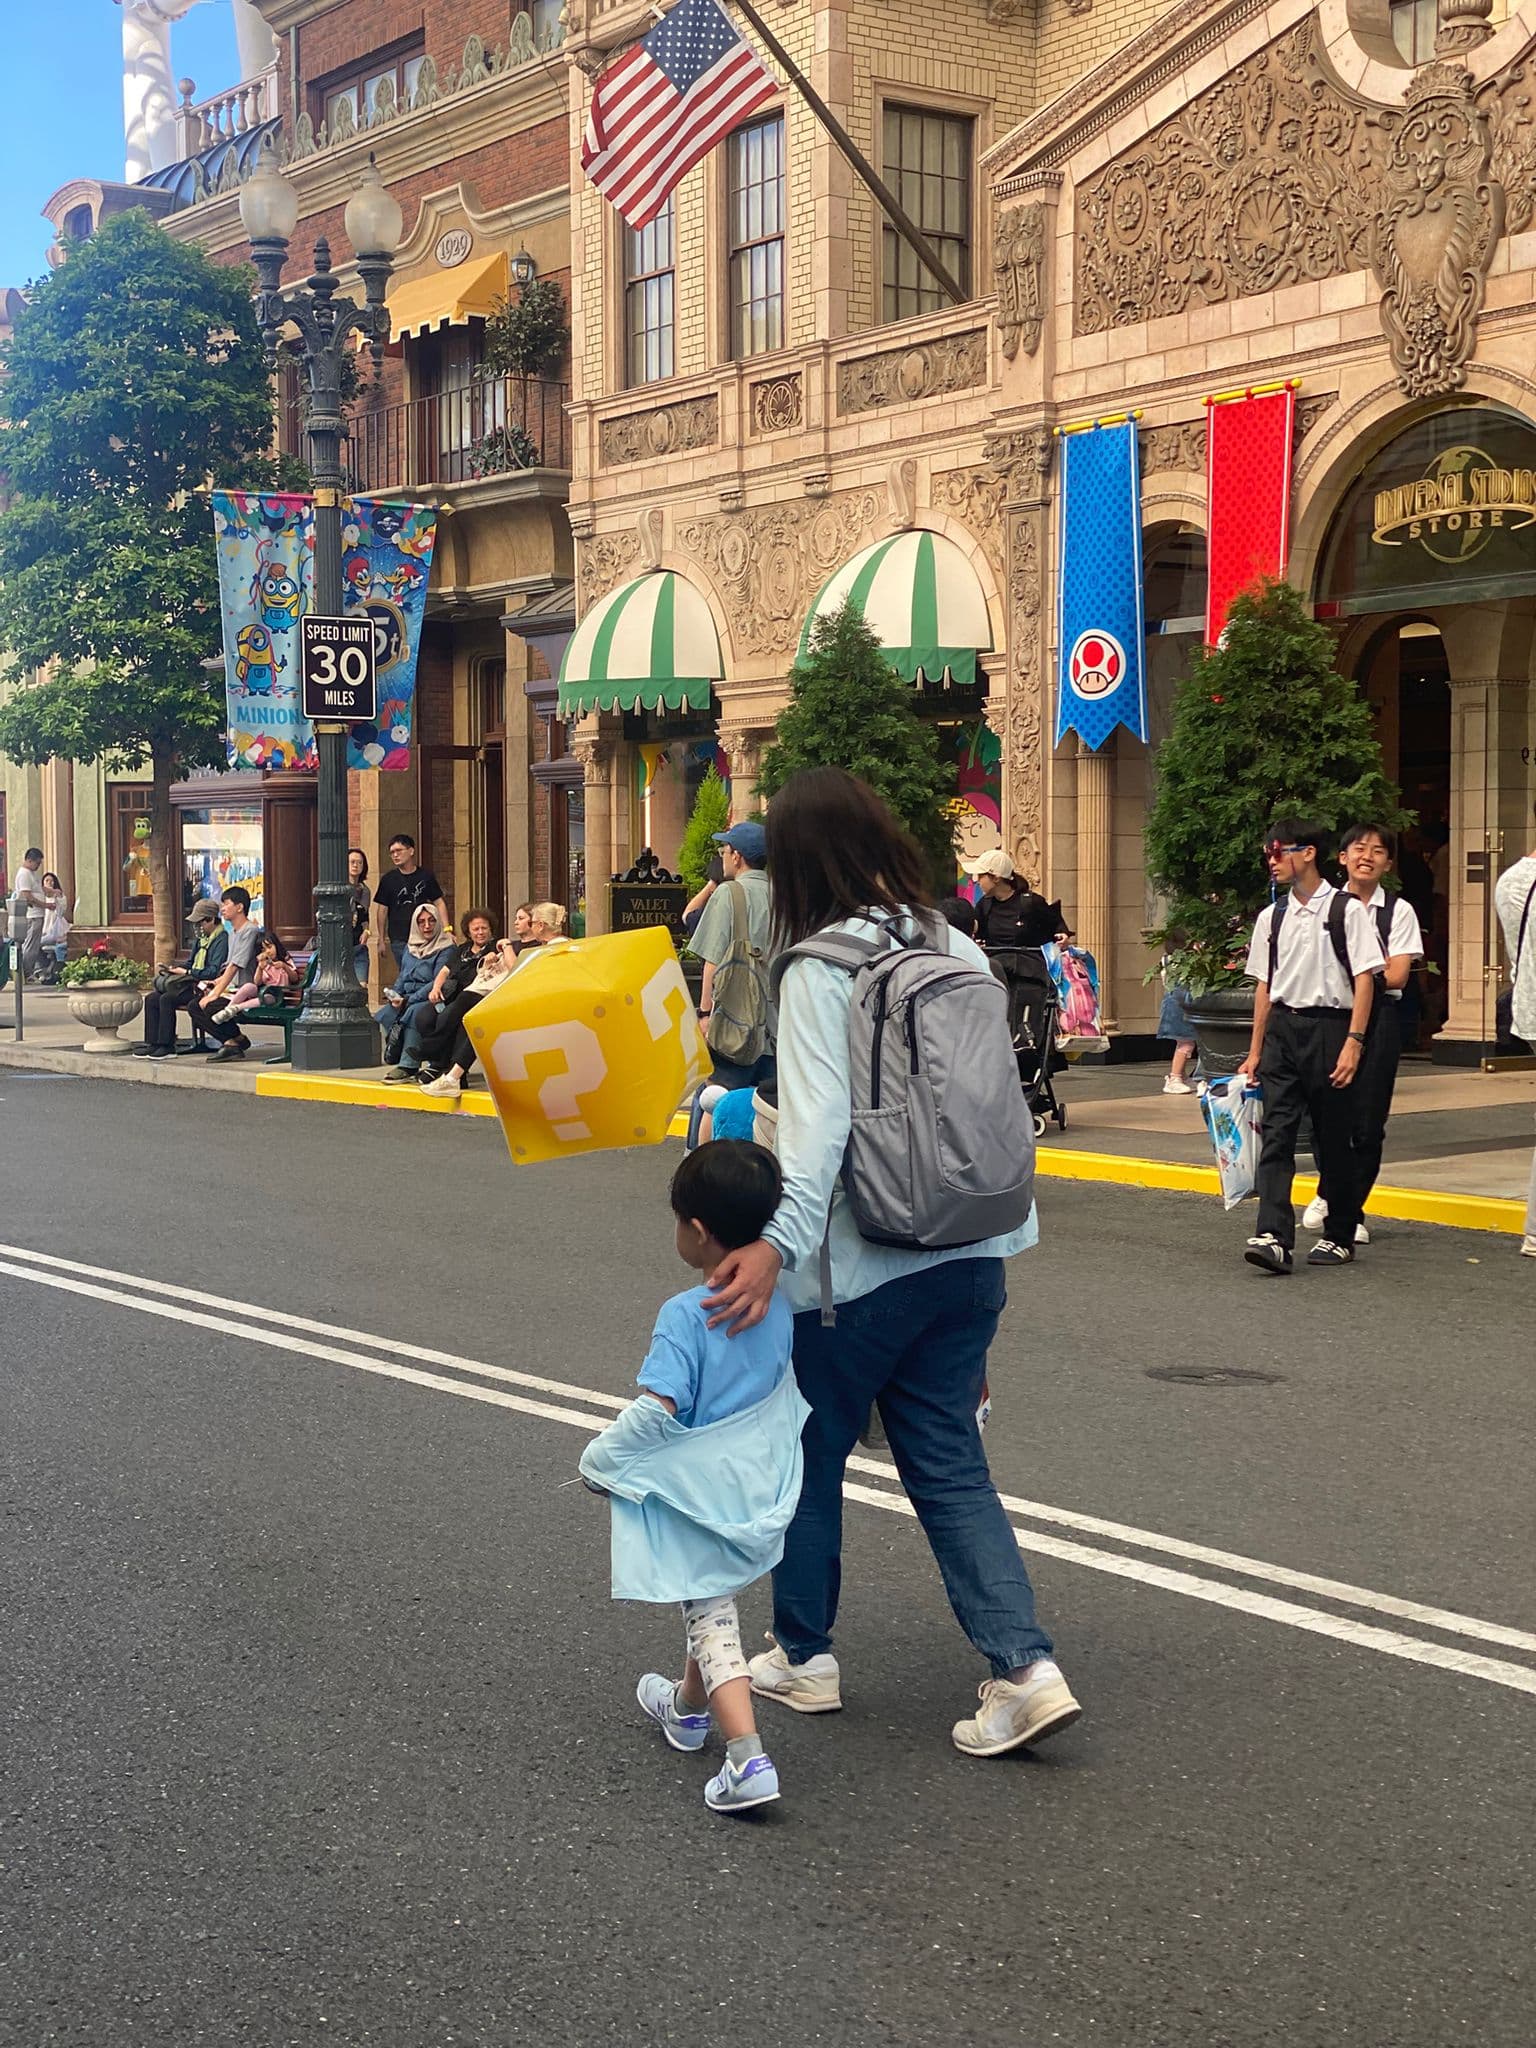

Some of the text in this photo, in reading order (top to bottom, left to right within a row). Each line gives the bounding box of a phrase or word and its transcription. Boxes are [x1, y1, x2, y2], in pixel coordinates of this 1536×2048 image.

[440, 235, 468, 261] 1929
[1375, 473, 1468, 529] UNIVERSAL
[1409, 510, 1503, 539] STORE
[306, 624, 370, 642] SPEED LIMIT
[310, 645, 368, 686] 30
[324, 690, 355, 706] MILES
[630, 898, 671, 911] VALET
[621, 912, 678, 924] PARKING
[490, 1019, 608, 1142] ?
